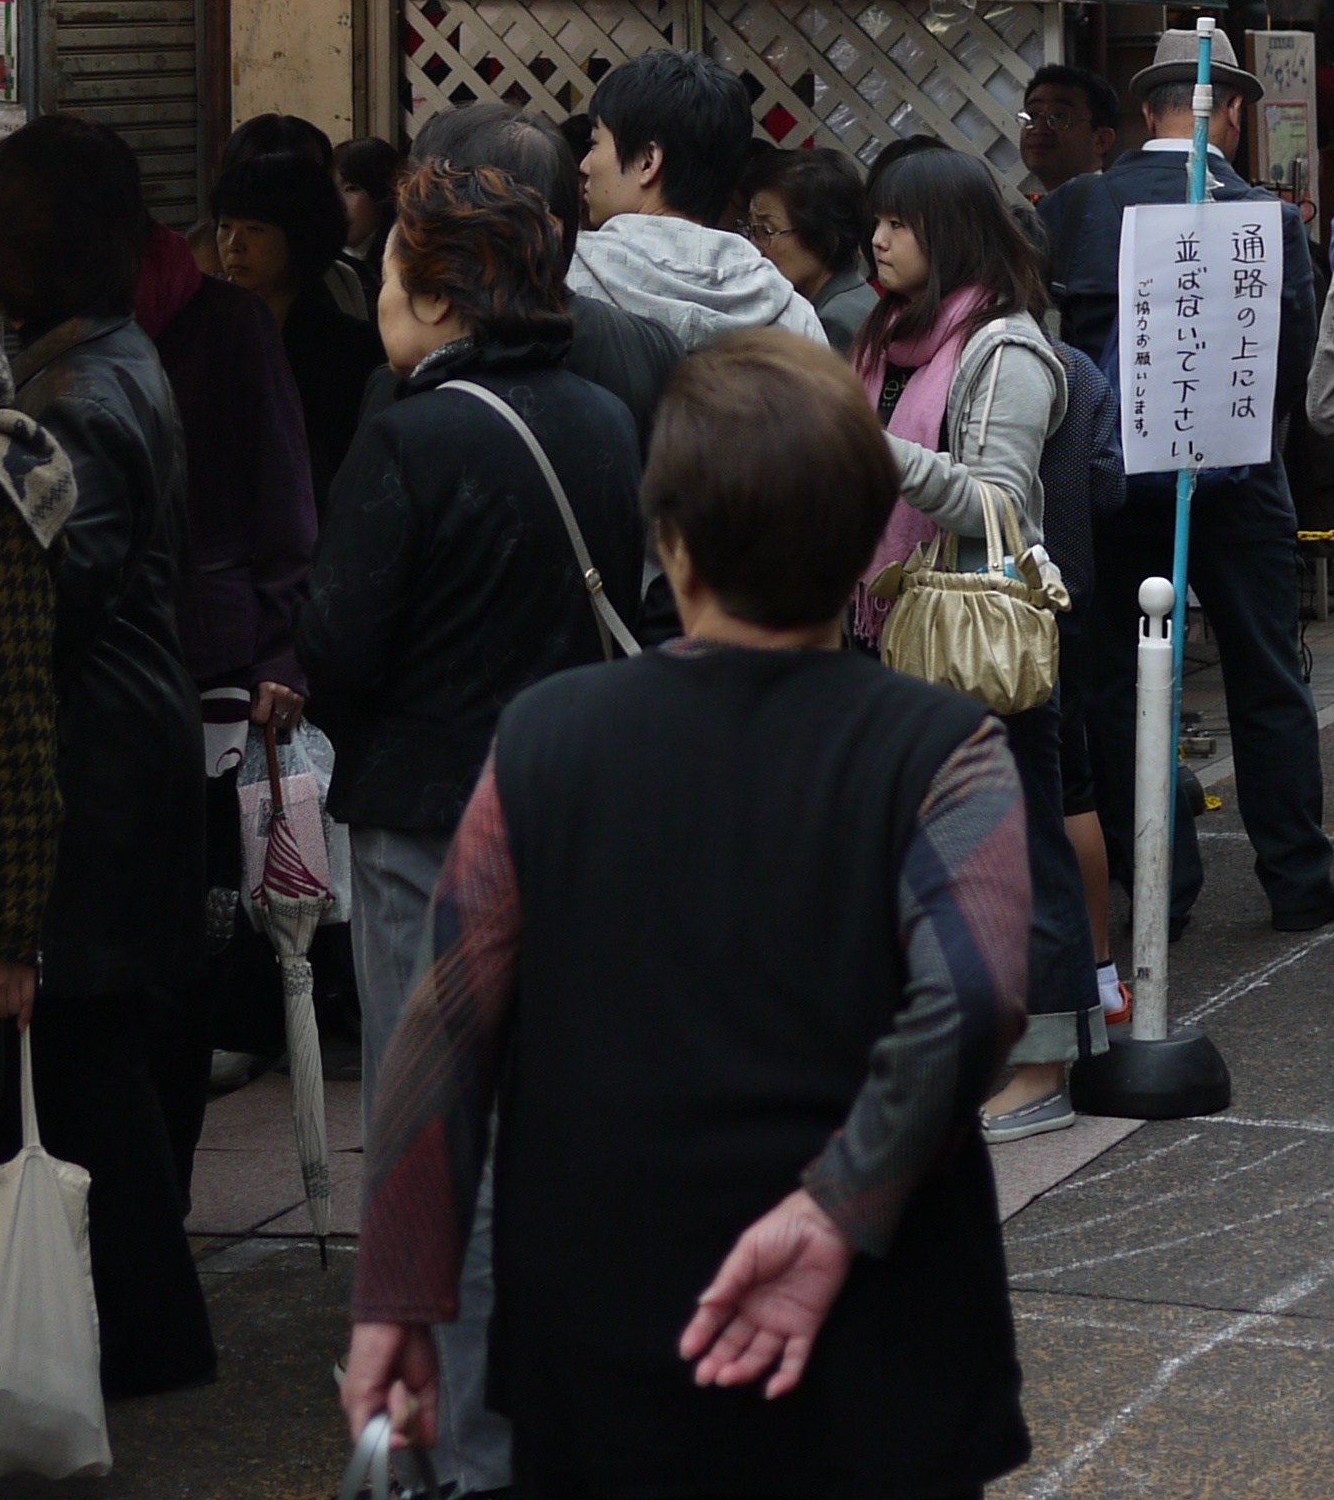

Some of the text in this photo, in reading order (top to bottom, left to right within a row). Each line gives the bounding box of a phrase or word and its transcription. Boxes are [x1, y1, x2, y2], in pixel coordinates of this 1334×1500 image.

[1134, 278, 1154, 438] ご協力お願いします。
[1171, 232, 1208, 462] 並ばないで下さい。
[1231, 223, 1268, 418] 通路の上には
